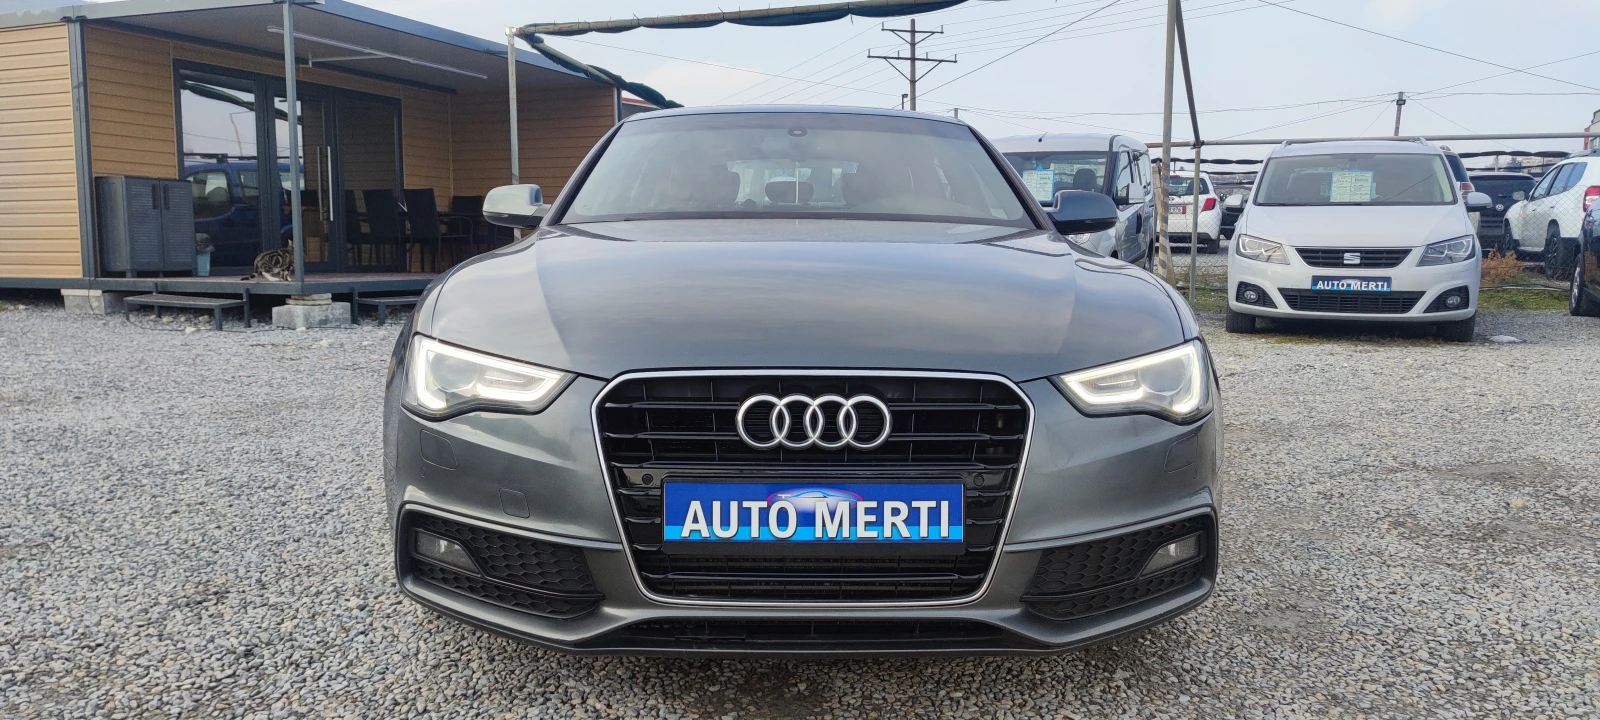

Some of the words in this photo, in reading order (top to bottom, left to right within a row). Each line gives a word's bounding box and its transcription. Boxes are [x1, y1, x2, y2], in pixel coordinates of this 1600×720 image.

[1316, 280, 1347, 290] AUTO
[1350, 281, 1388, 291] MERTI
[680, 501, 797, 539] AUTO
[814, 501, 950, 539] MERTI
